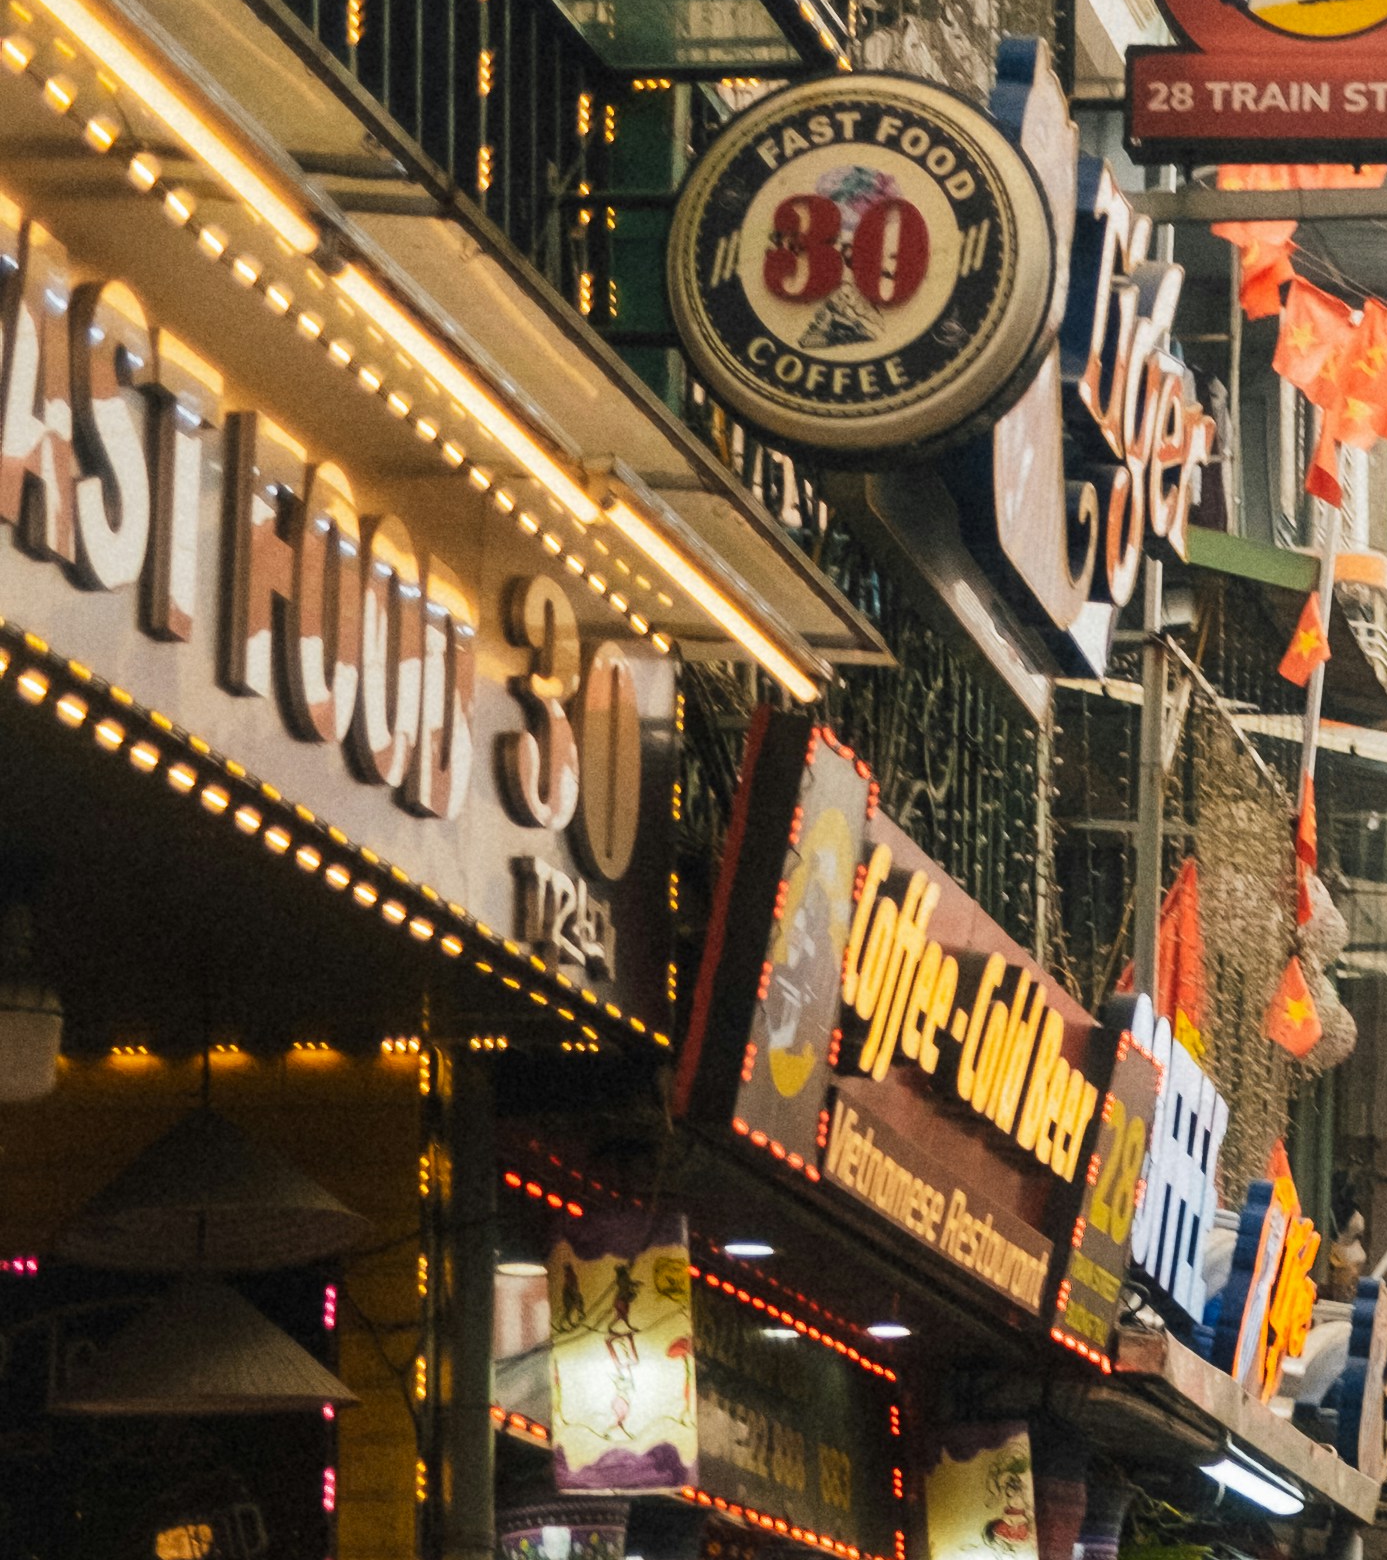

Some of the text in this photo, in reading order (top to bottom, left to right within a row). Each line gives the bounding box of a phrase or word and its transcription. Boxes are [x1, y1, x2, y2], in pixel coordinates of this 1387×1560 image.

[756, 111, 976, 200] FAST FOOD
[1147, 81, 1194, 113] 28
[1205, 81, 1331, 113] TRAIN
[762, 194, 930, 308] 30
[747, 337, 908, 395] COFFEE
[0, 220, 641, 880] AST FOOD 30
[840, 844, 961, 1083] Coffee
[957, 955, 1046, 1135] Cold
[1016, 1007, 1099, 1184] Beer
[825, 1099, 1050, 1311] Vietnamese Restaurant
[1089, 1099, 1147, 1245] 28
[1131, 992, 1230, 1325] OFFEE
